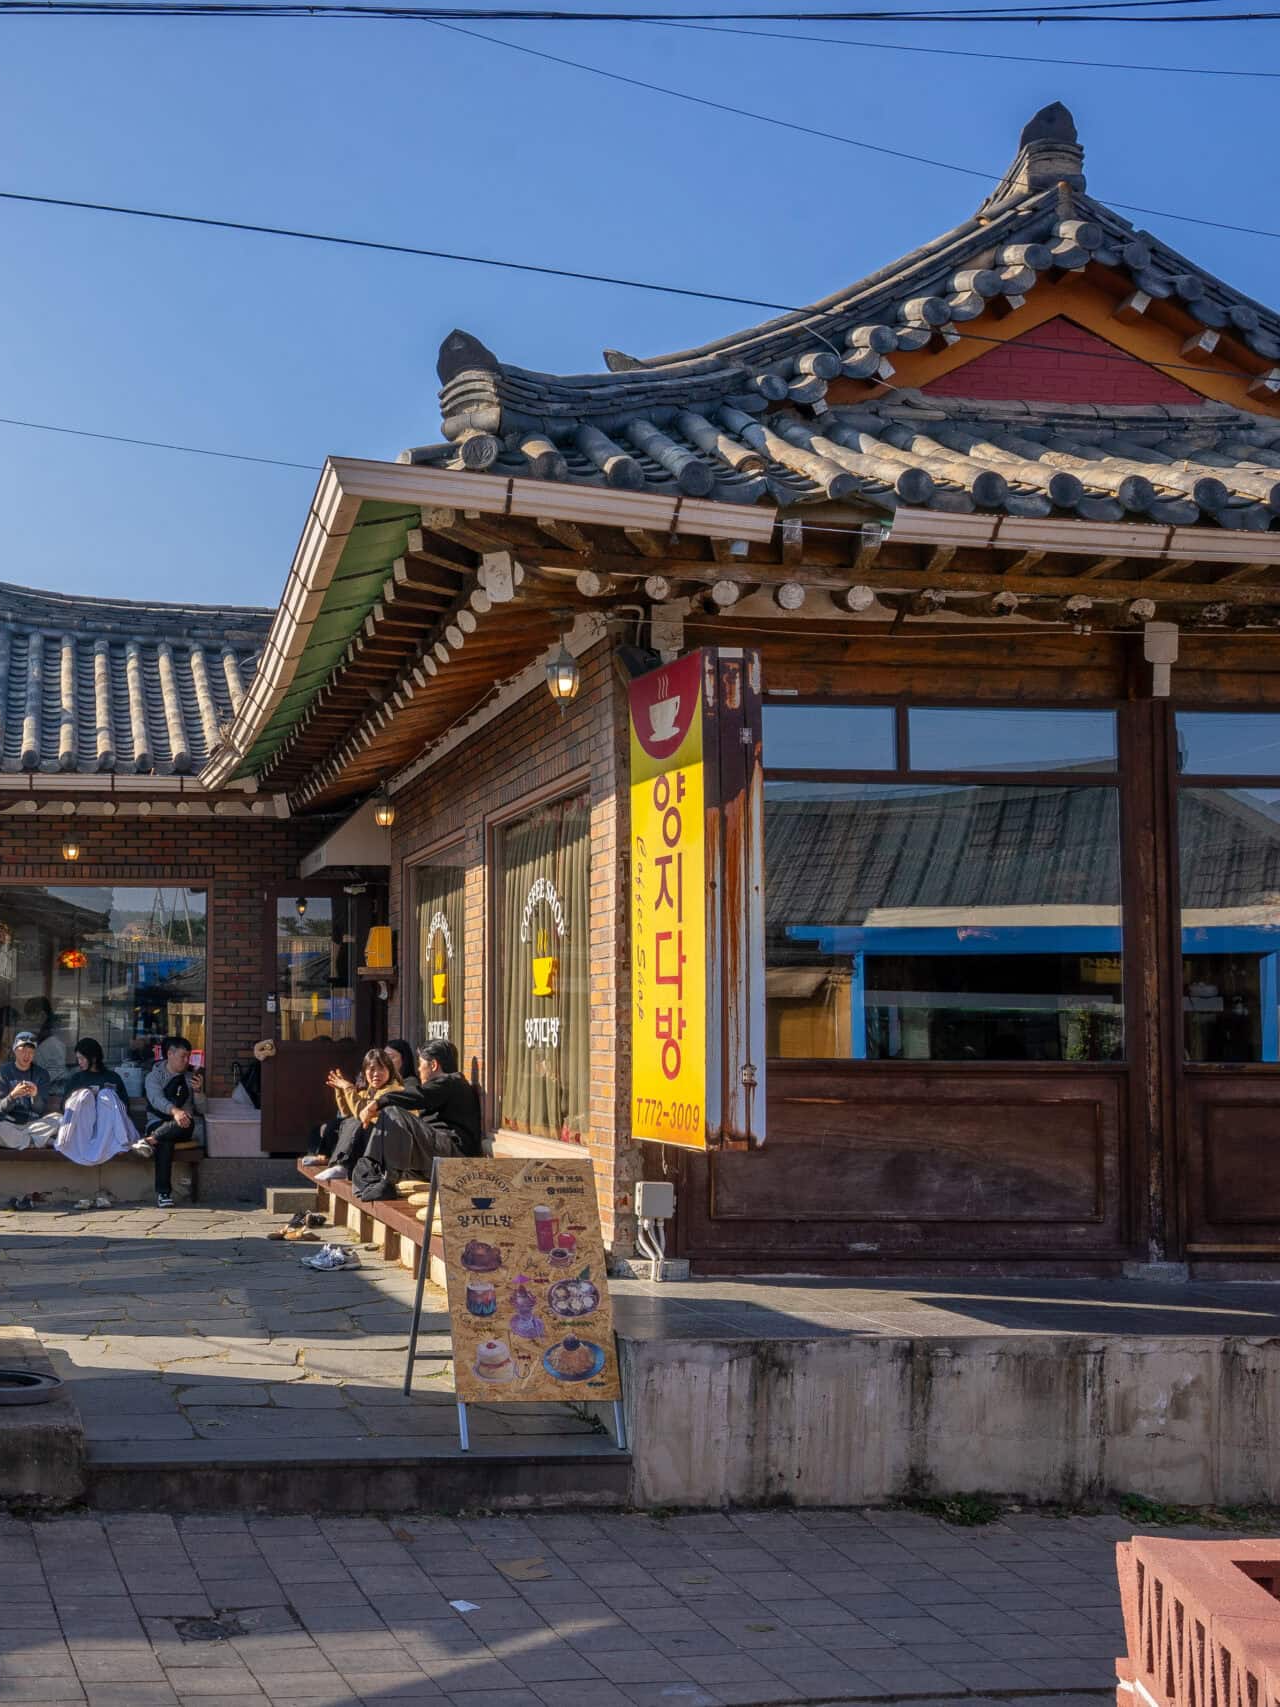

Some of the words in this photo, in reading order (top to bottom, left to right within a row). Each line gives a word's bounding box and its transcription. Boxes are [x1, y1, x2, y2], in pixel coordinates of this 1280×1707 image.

[521, 878, 545, 943] COFFEE
[545, 880, 564, 937] SHOP
[653, 771, 687, 1080] 양지다방
[525, 1017, 560, 1048] 양지다방
[636, 1097, 700, 1133] T.772-3009
[457, 1214, 513, 1229] 양지다방
